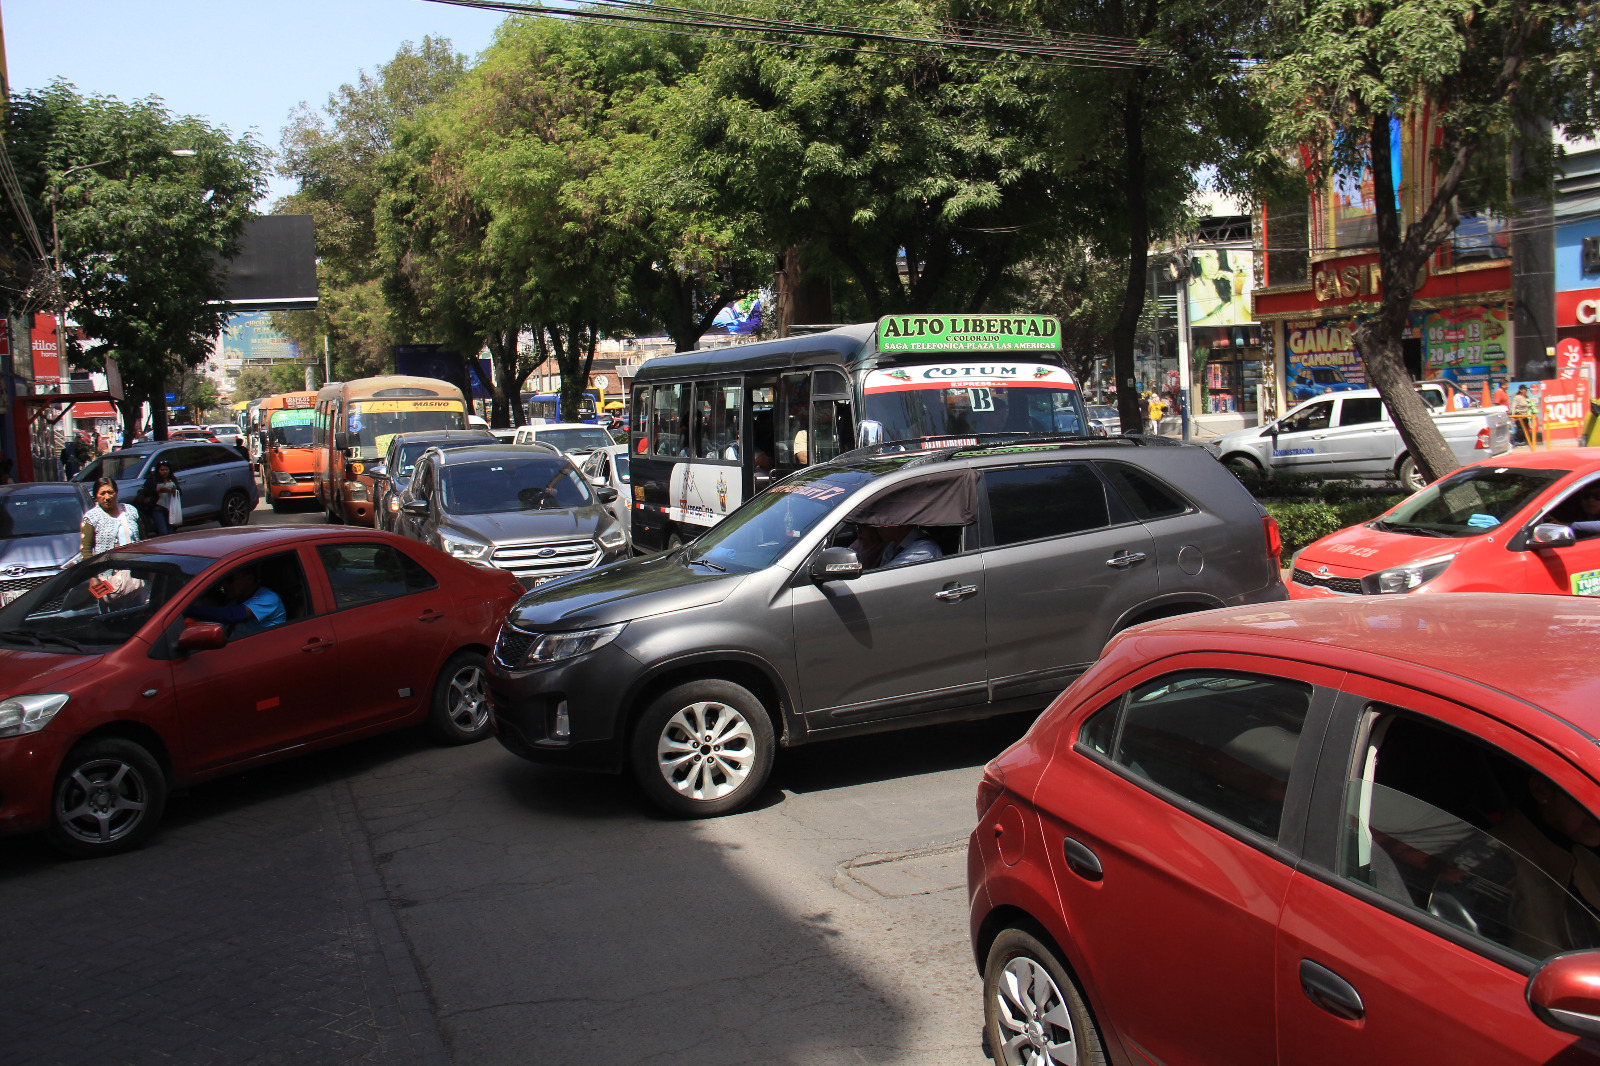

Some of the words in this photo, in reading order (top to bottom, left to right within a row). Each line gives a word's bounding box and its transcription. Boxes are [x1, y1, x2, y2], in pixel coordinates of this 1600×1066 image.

[883, 317, 945, 337] ALTO
[949, 318, 1057, 337] LIBERTAD
[1429, 327, 1444, 340] 06
[1468, 323, 1480, 337] 13
[884, 342, 909, 350] SAGA
[1289, 327, 1354, 354] GANAR
[1301, 352, 1357, 367] CAMIONETA
[1429, 348, 1444, 361] 20
[1467, 345, 1481, 360] 27
[923, 366, 1017, 379] COTUM
[971, 388, 991, 410] B
[1544, 397, 1583, 423] AQUÍ
[349, 414, 362, 433] 5
[924, 441, 941, 450] ALTO
[1577, 576, 1600, 590] TUR
